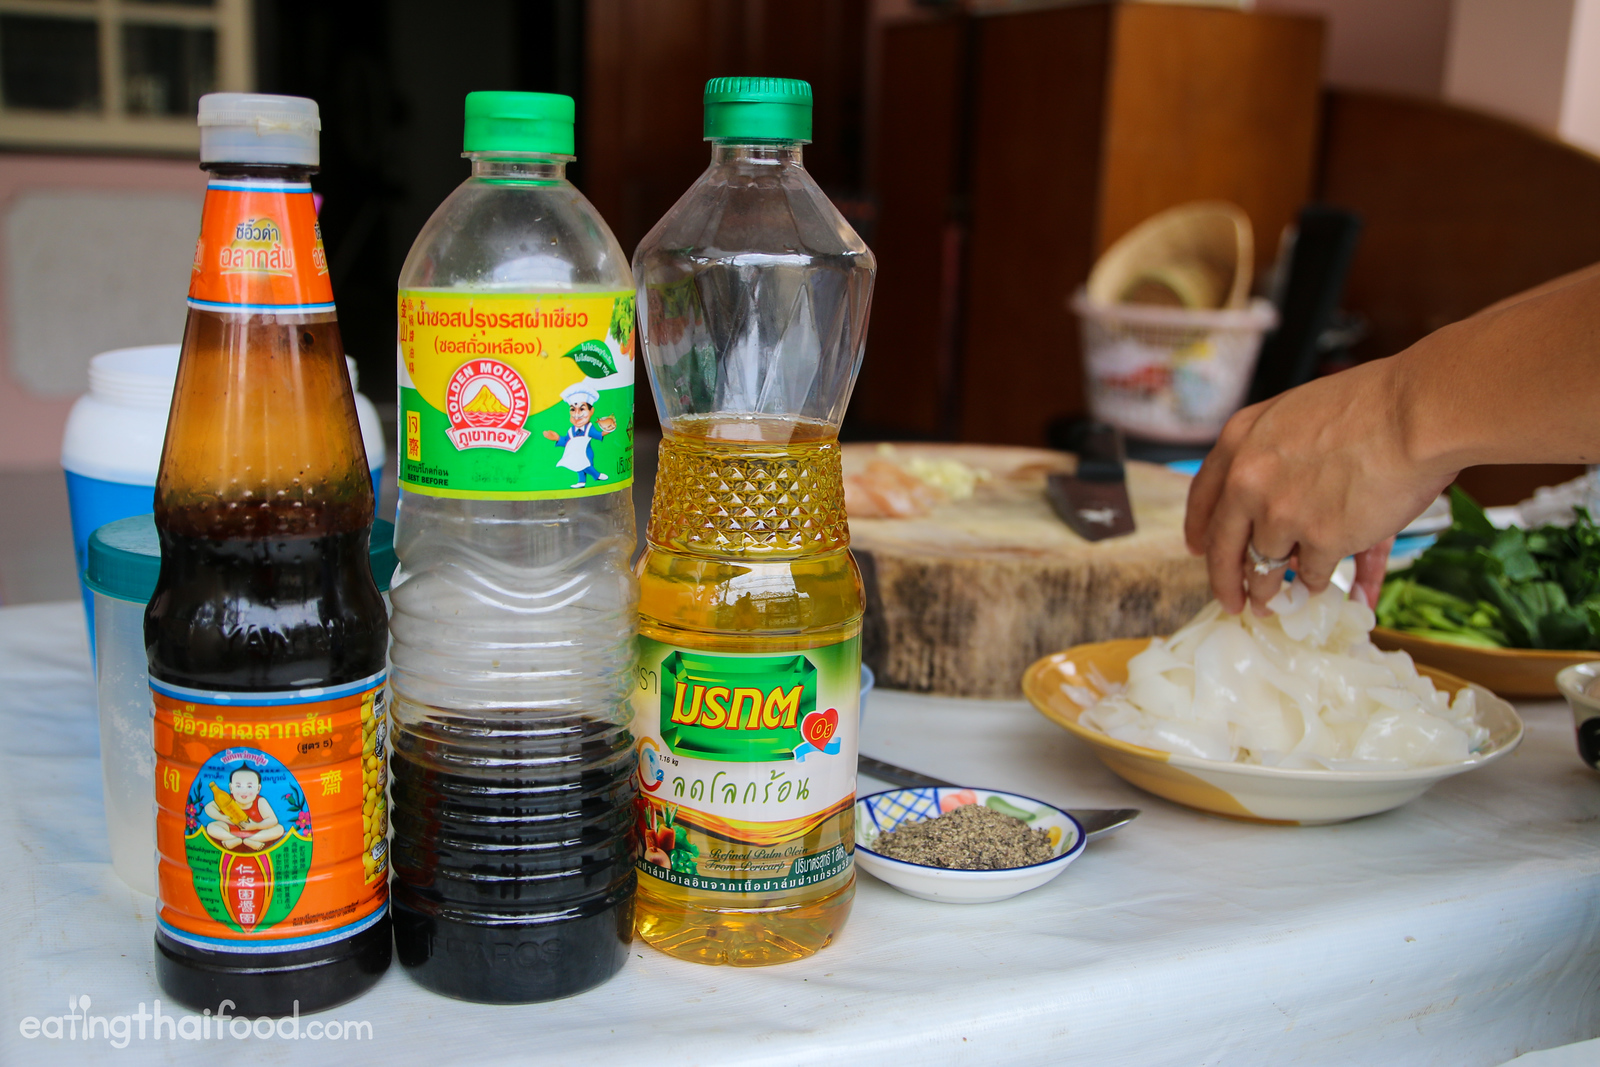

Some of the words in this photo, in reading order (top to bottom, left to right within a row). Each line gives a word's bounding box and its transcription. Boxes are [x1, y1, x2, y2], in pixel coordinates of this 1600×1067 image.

[220, 243, 293, 269] ฉลากส้ม
[433, 334, 542, 356] (ซอสถั่วเหลือง)
[449, 365, 474, 424] GOLDEN
[480, 362, 526, 426] MOUNTAIN
[459, 430, 516, 447] ภูเขาทอง
[407, 473, 420, 482] BEST
[421, 476, 449, 486] BEFORE
[671, 682, 805, 730] มรกต
[172, 704, 333, 740] ซีอิ๊วดำฉลากส้ม
[297, 741, 321, 755] (สูตร
[323, 737, 333, 750] 5)
[659, 754, 671, 764] 1.16
[672, 758, 679, 767] kg
[672, 770, 810, 804] ลดโลกร้อน
[709, 848, 753, 863] Refined
[753, 848, 782, 860] Palm
[784, 846, 808, 858] Olein
[704, 859, 736, 871] From
[740, 860, 786, 873] Pericarp
